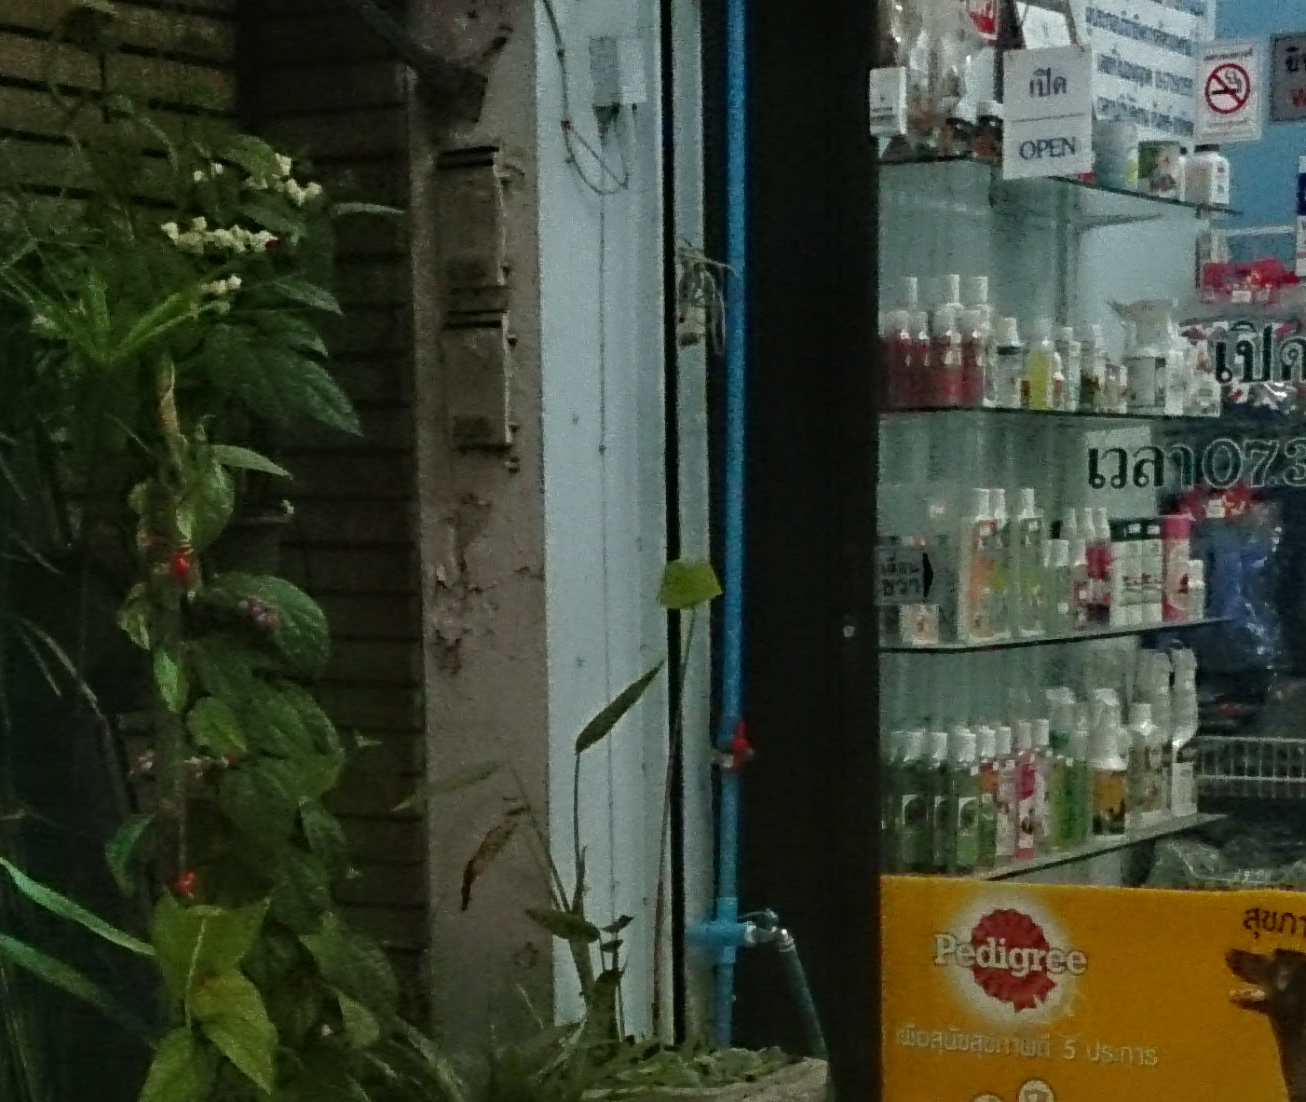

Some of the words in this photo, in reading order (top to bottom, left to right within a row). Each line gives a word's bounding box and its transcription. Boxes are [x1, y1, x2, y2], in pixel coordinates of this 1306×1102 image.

[1029, 67, 1067, 98] เปิด
[1019, 137, 1075, 160] OPEN
[933, 932, 1088, 977] Pedigree
[1063, 1039, 1077, 1060] 5
[1086, 1038, 1159, 1067] ประการ
